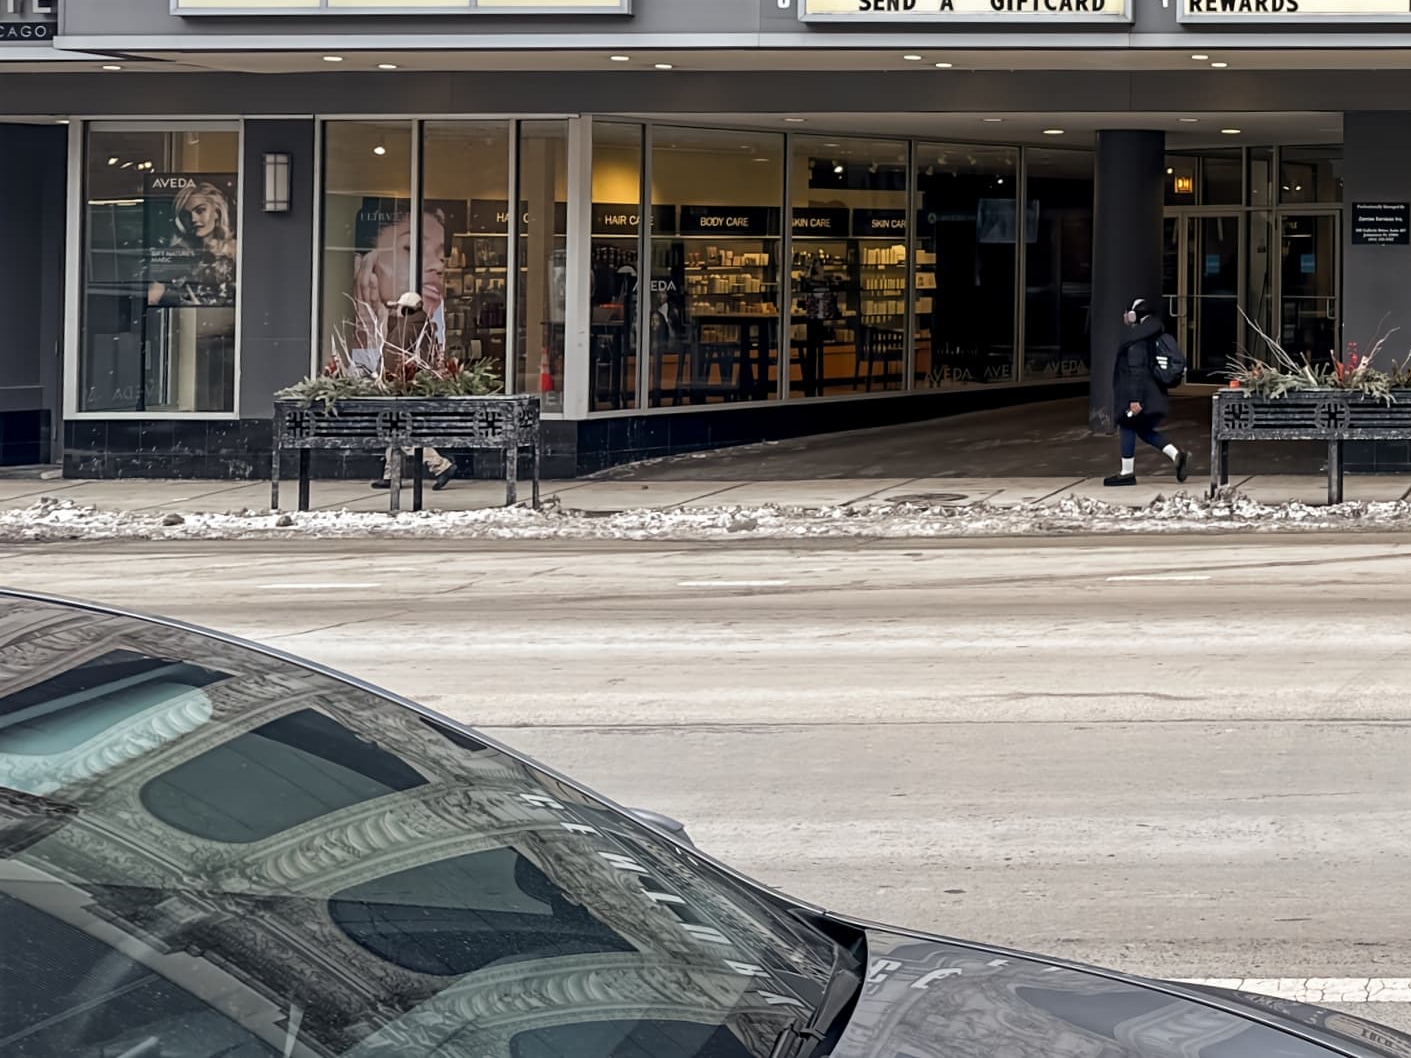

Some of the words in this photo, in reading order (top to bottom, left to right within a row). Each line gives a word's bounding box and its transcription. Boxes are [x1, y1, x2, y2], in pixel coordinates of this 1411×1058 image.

[152, 178, 197, 188] AVEDA
[605, 215, 626, 226] HAIR
[629, 216, 654, 226] CAE
[700, 217, 724, 227] BODY
[726, 217, 749, 227] CARE
[810, 218, 831, 228] CARE
[872, 219, 890, 228] SKIN
